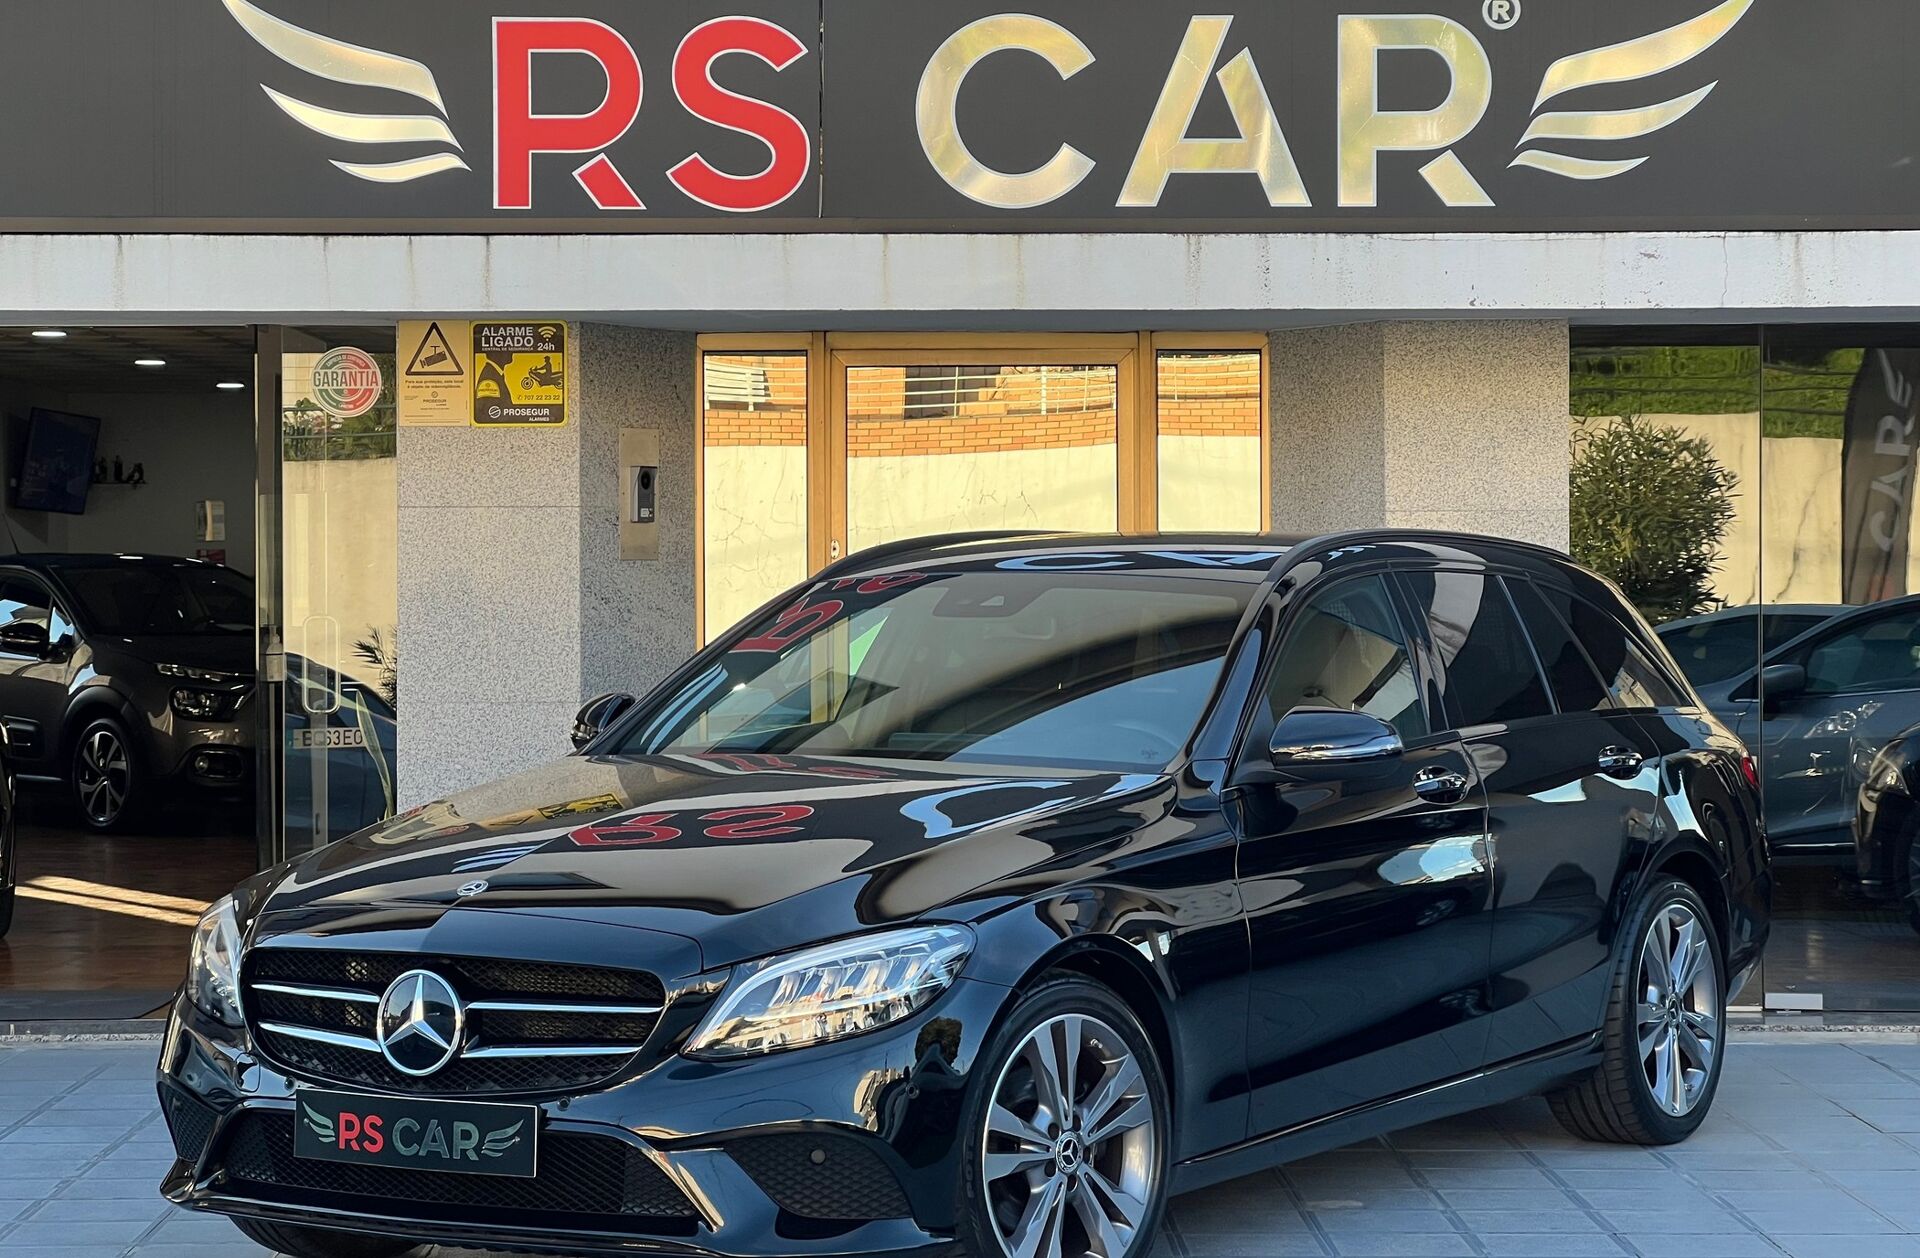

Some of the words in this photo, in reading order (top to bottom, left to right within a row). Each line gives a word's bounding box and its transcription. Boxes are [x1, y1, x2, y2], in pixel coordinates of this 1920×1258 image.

[492, 16, 811, 212] RS
[915, 13, 1496, 208] CAR
[482, 326, 534, 336] ALARME
[481, 336, 534, 347] LIGADO
[537, 342, 555, 351] 24h
[314, 371, 379, 387] GARANTIA
[503, 408, 550, 416] PROSEGUR
[1870, 415, 1915, 551] CAR
[338, 1111, 384, 1153] RS
[391, 1117, 480, 1161] CAR
